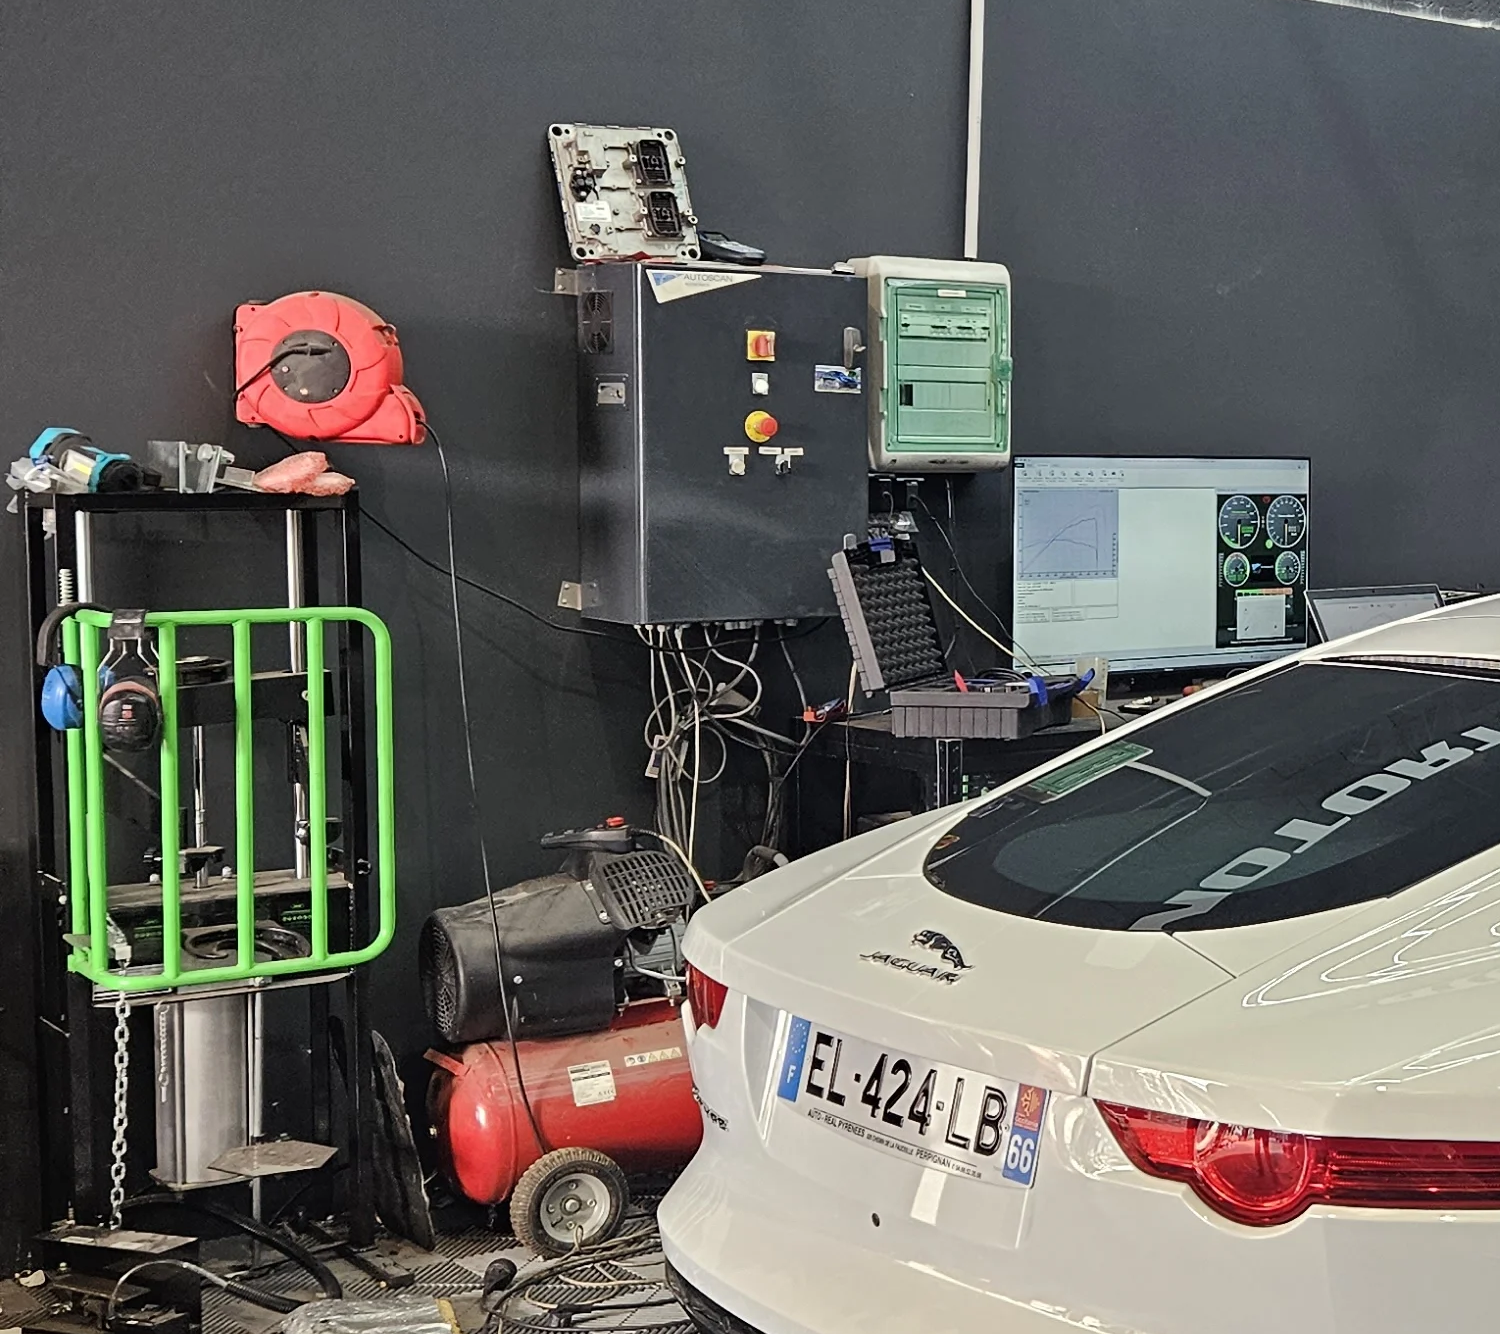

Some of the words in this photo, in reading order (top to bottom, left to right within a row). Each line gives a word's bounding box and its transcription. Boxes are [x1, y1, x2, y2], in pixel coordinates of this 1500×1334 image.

[683, 273, 734, 283] AUTOSCAN
[859, 950, 964, 985] JAGUAR
[786, 1064, 797, 1084] F
[824, 1115, 837, 1129] REAL
[915, 1149, 951, 1168] PERPIGNAN
[1007, 1134, 1036, 1175] 66
